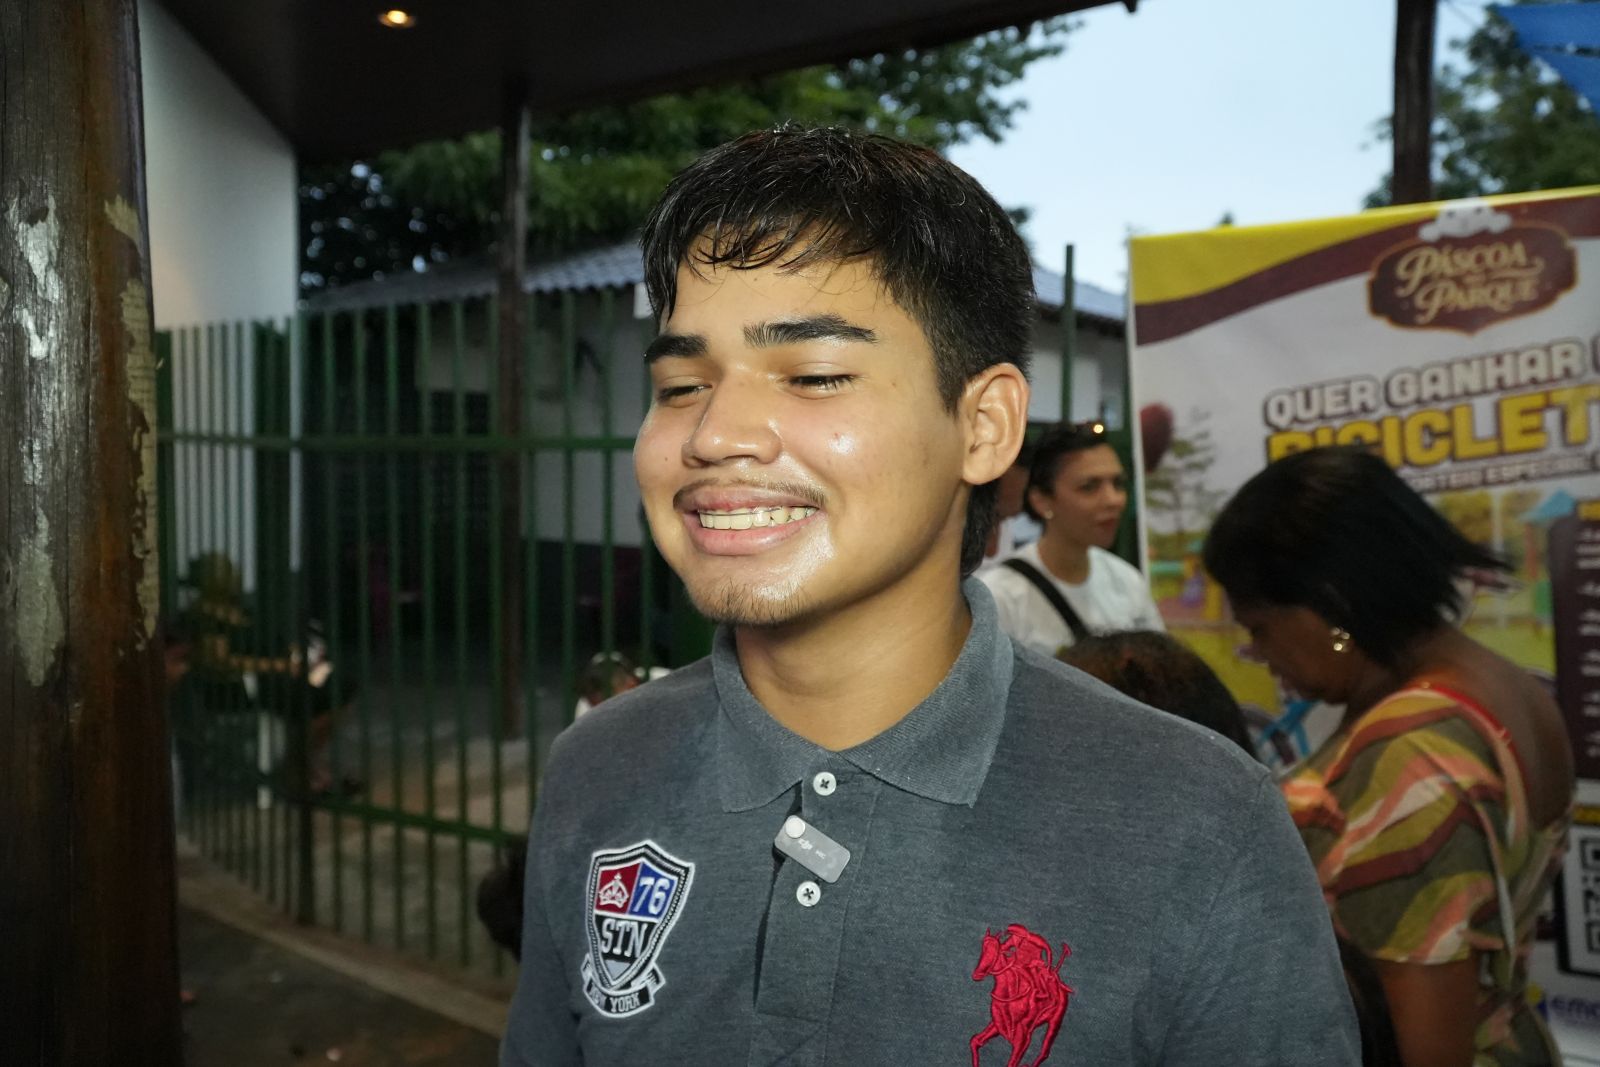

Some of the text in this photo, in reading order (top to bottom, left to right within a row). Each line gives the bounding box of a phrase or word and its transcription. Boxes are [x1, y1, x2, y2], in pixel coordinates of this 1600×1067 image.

[1414, 278, 1539, 325] PARQUE
[1266, 378, 1379, 430] QUER
[1387, 342, 1585, 406] GANHAR
[633, 876, 671, 915] 76
[602, 919, 648, 958] STN
[609, 992, 640, 1013] YORK
